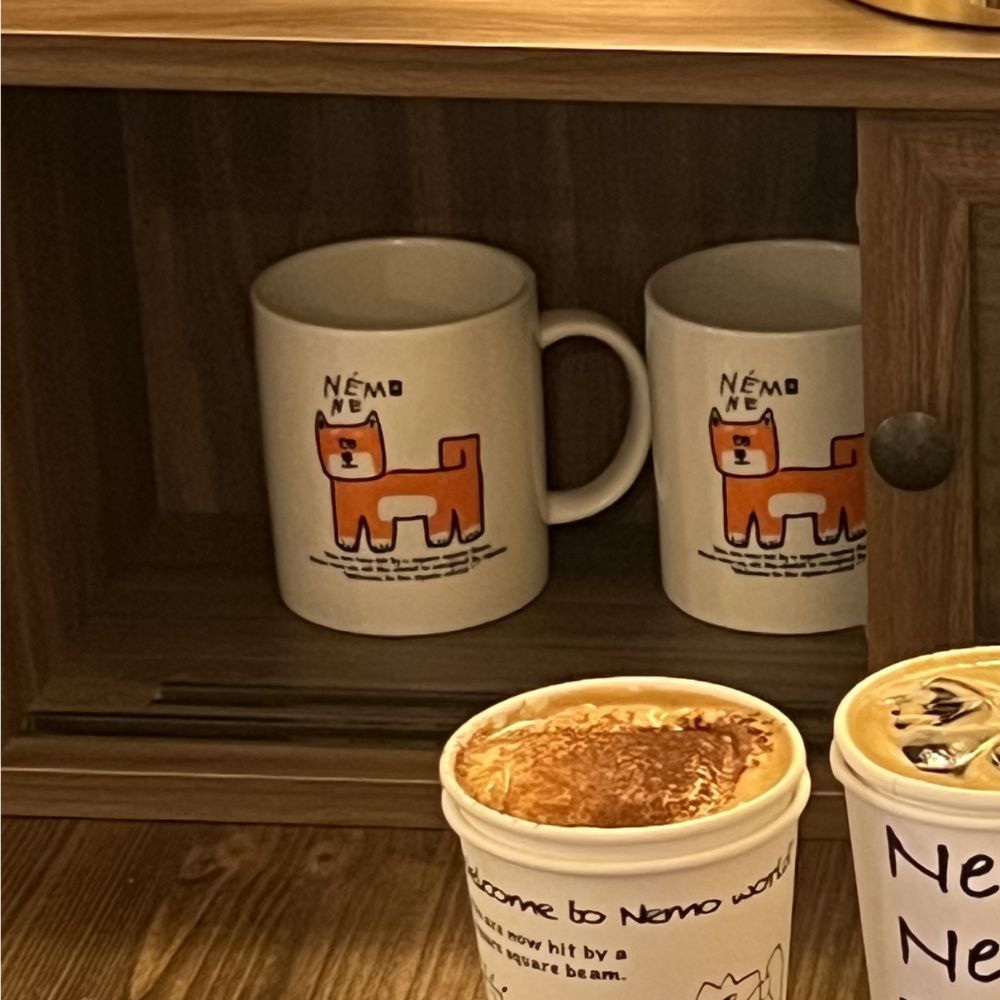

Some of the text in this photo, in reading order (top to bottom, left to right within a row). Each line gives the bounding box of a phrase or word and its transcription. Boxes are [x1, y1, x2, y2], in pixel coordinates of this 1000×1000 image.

[468, 865, 559, 921] elcome
[568, 900, 607, 924] to
[620, 899, 722, 926] Nemo
[507, 930, 542, 951] now
[548, 939, 576, 958] hit
[584, 945, 608, 962] by
[615, 949, 628, 960] a
